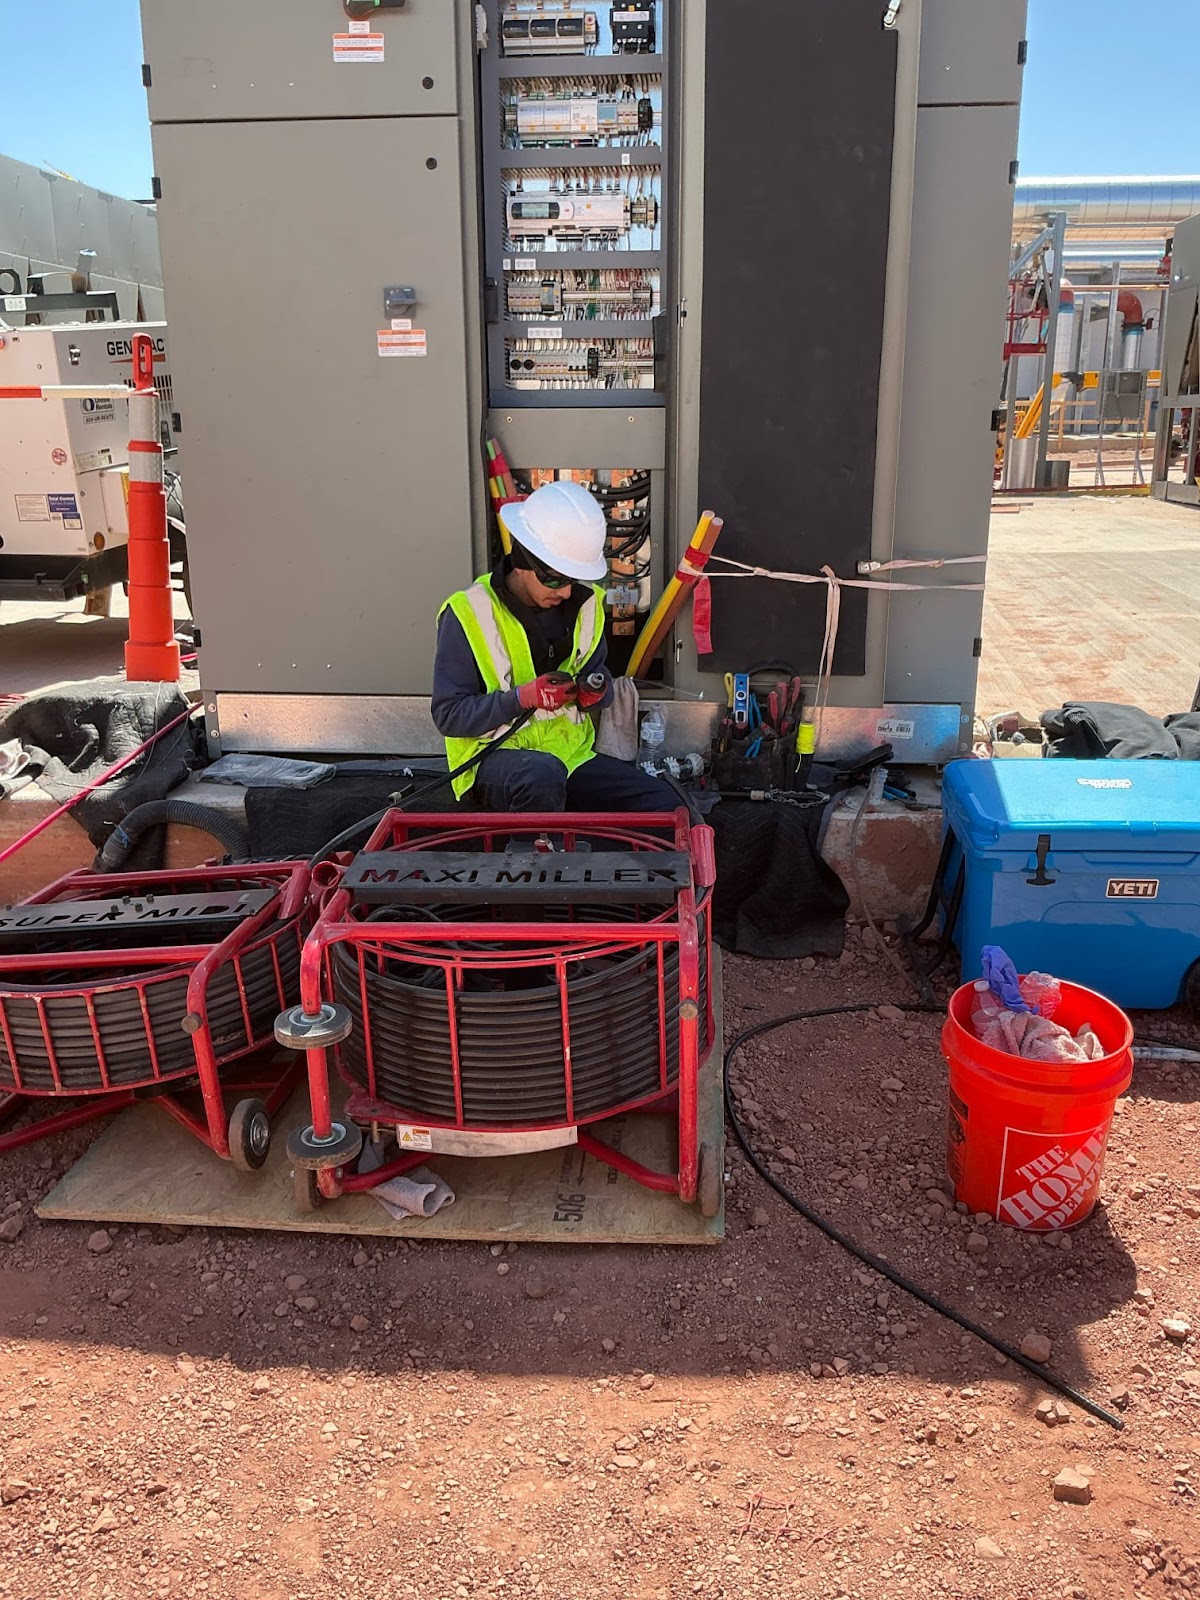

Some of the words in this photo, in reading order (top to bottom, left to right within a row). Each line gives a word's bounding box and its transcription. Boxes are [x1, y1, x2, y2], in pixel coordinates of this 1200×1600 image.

[359, 869, 479, 884] MAXI
[496, 868, 679, 884] MILLER
[1111, 882, 1154, 895] YETI
[0, 911, 124, 928] SUPER
[137, 903, 248, 920] MIDI
[1000, 1126, 1104, 1229] HOME
[1014, 1144, 1070, 1184] THE
[552, 1193, 587, 1223] 506
